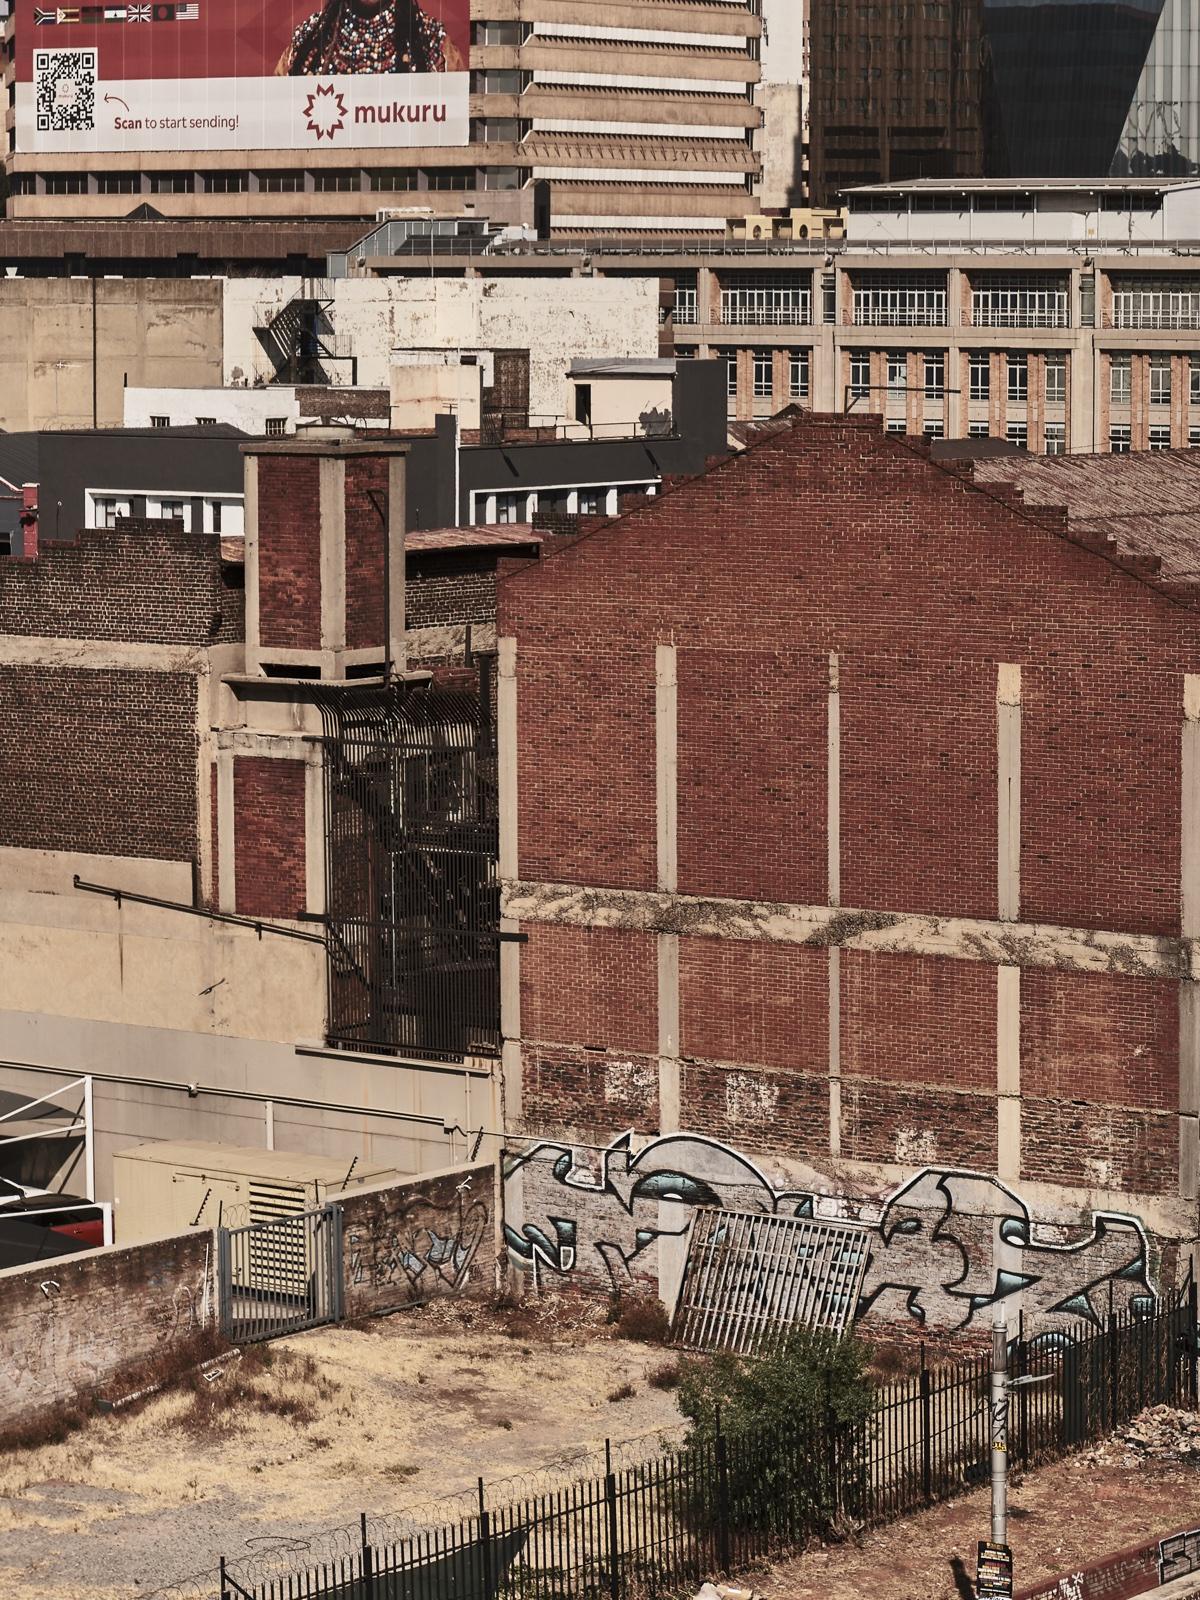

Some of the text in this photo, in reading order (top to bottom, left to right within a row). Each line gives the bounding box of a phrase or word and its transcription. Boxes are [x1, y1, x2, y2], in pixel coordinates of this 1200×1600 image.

[355, 101, 446, 123] mukuru
[114, 115, 239, 131] Scan to start sending!
